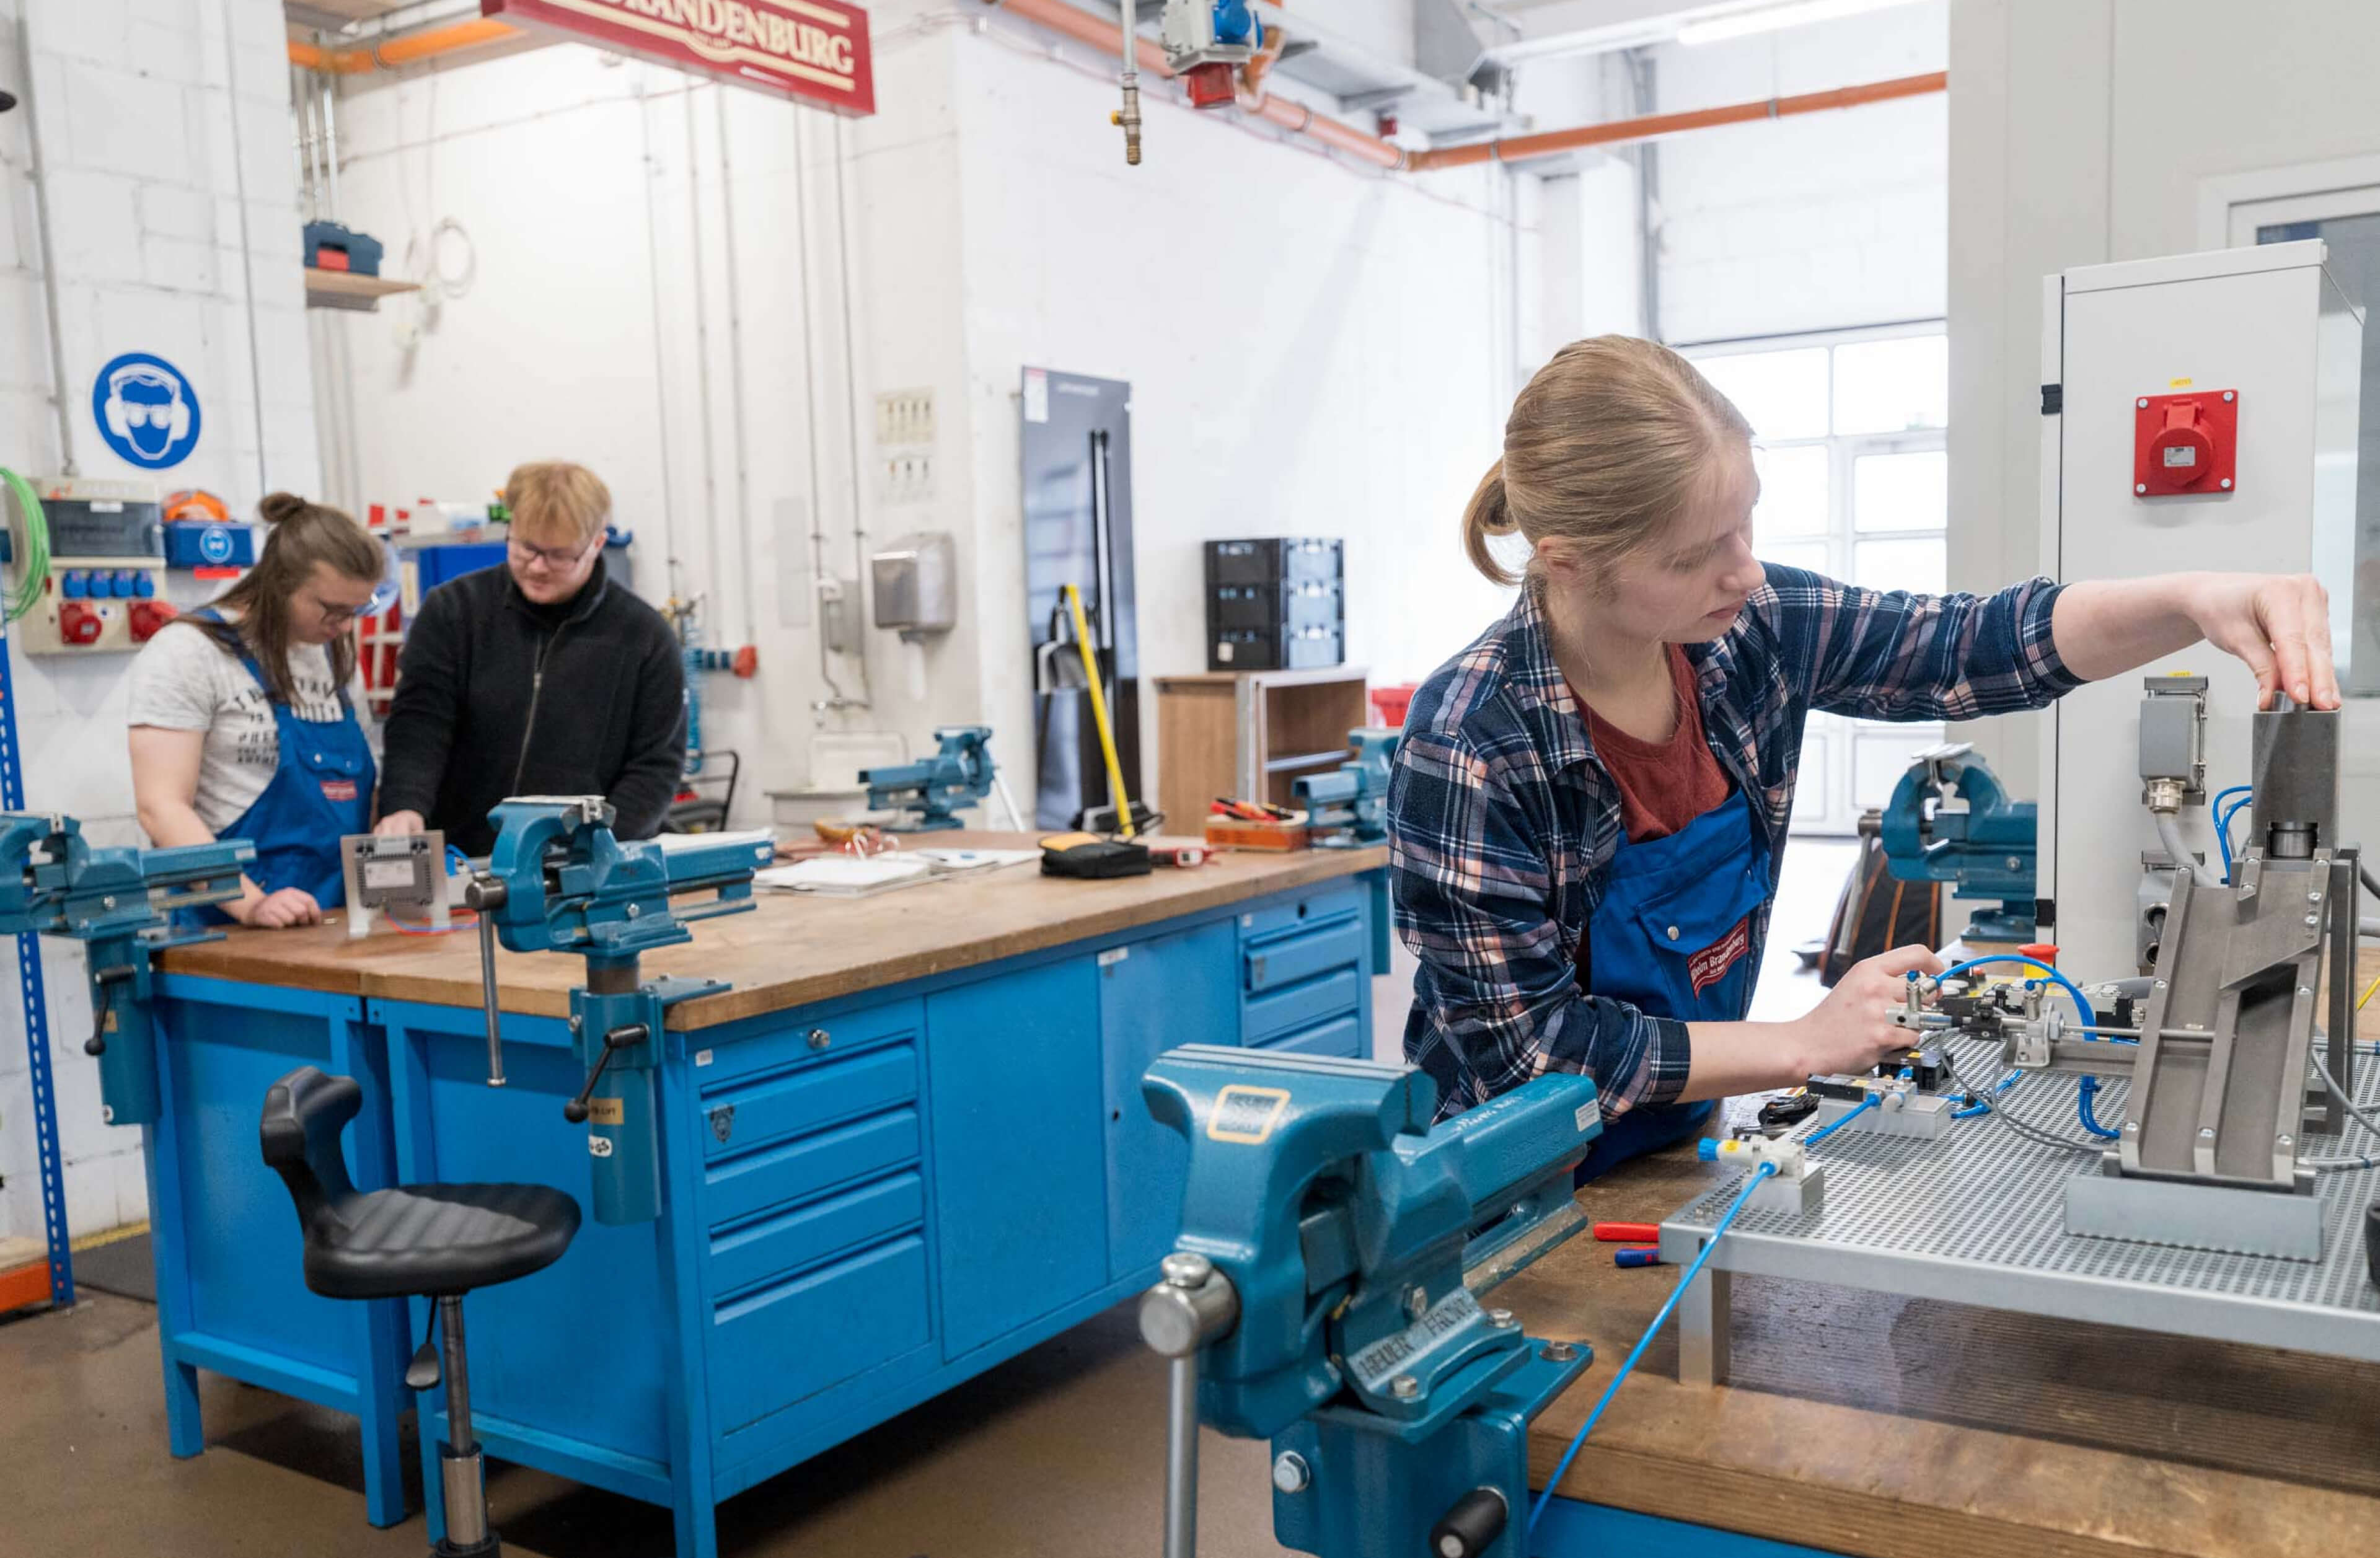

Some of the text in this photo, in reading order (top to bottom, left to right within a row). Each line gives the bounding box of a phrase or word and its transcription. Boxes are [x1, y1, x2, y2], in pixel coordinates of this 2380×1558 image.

[600, 0, 855, 74] ANDENBURG
[1709, 933, 1745, 968] Brandenburg
[1359, 1336, 1416, 1380] HEUER
